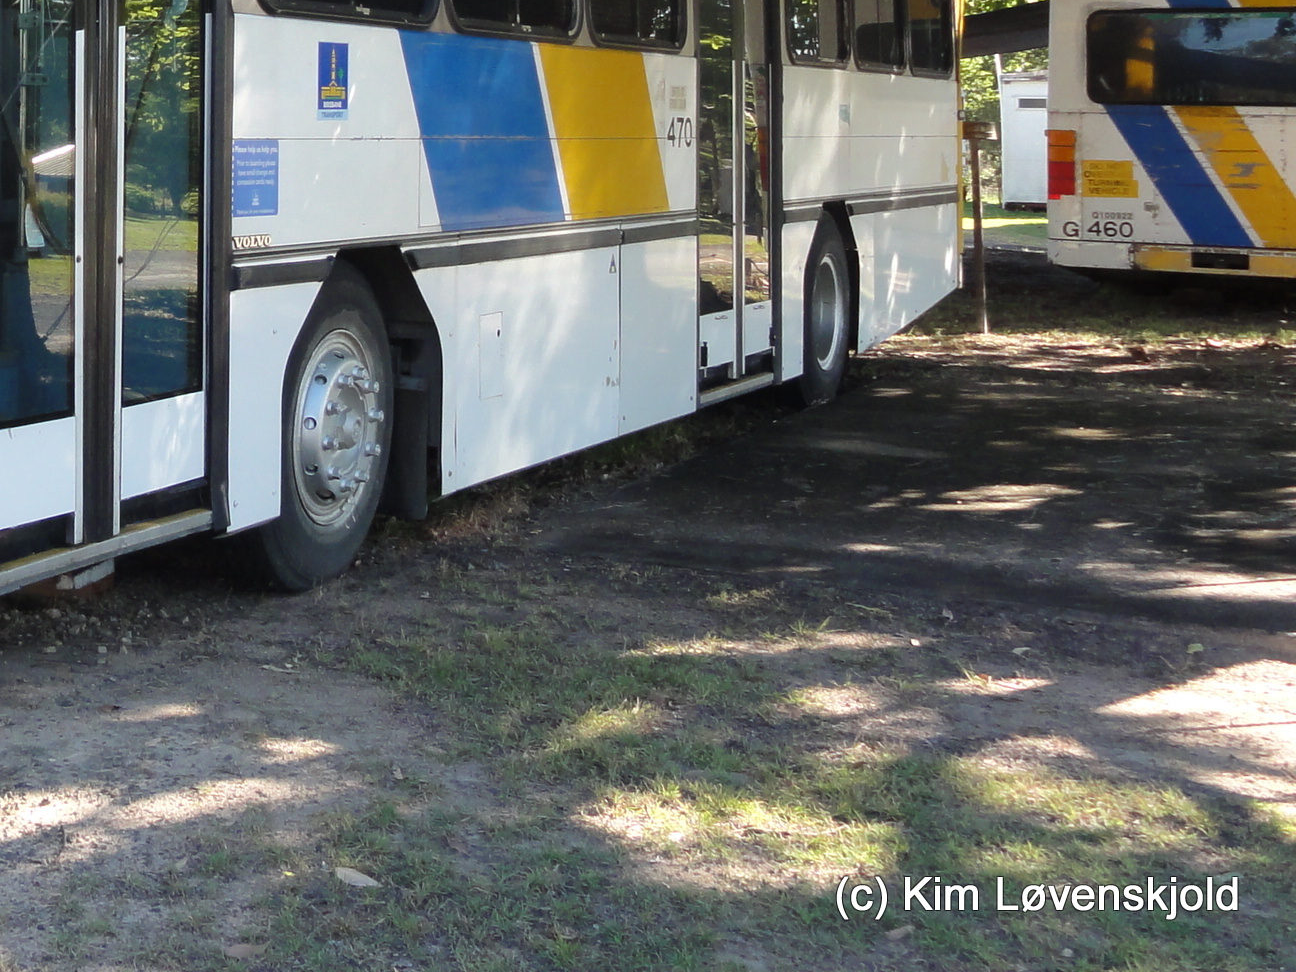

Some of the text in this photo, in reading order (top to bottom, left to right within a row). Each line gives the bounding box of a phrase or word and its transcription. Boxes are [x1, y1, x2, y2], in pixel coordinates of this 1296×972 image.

[667, 117, 693, 148] 470
[1063, 221, 1134, 238] G 460
[233, 234, 272, 248] VOLVO
